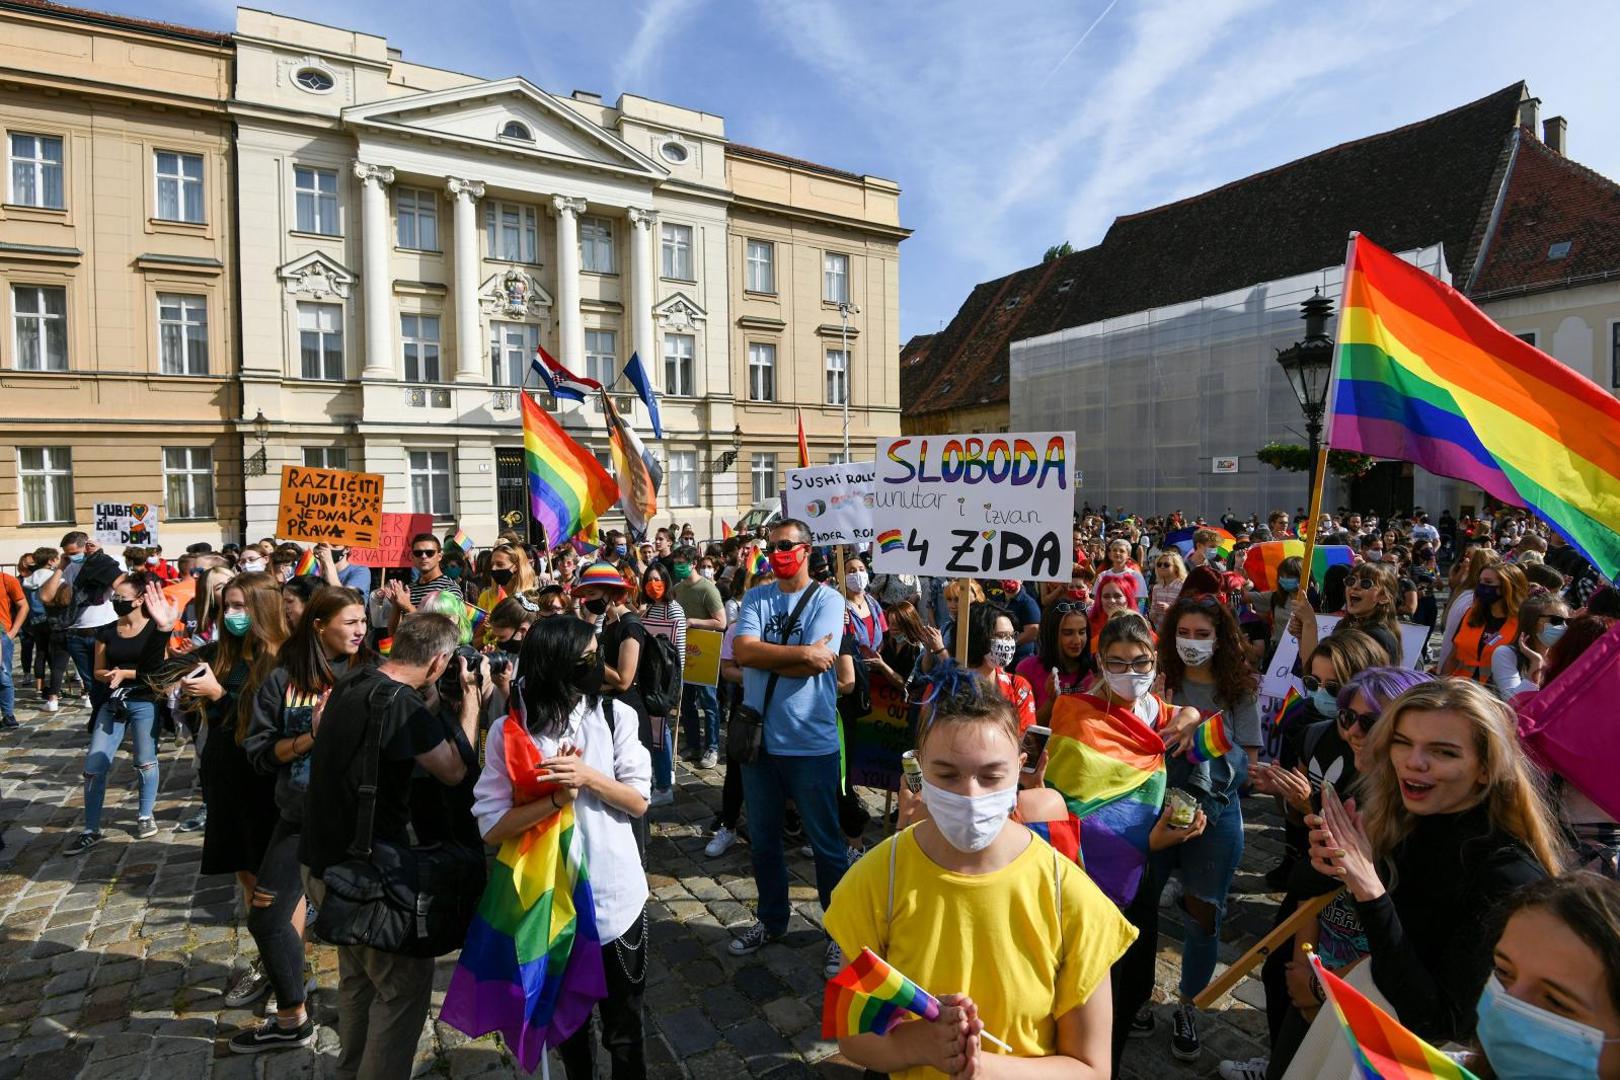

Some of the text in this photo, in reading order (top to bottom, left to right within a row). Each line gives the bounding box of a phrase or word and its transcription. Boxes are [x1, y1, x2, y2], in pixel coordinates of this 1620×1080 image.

[883, 436, 1067, 490] SLOBODA
[288, 468, 378, 495] RAZLIČITI
[296, 508, 373, 526] JEDNAKA
[875, 485, 1042, 524] unutar i izvan
[287, 519, 345, 538] PRAVA
[811, 531, 845, 543] ENDER
[907, 528, 929, 566] 4
